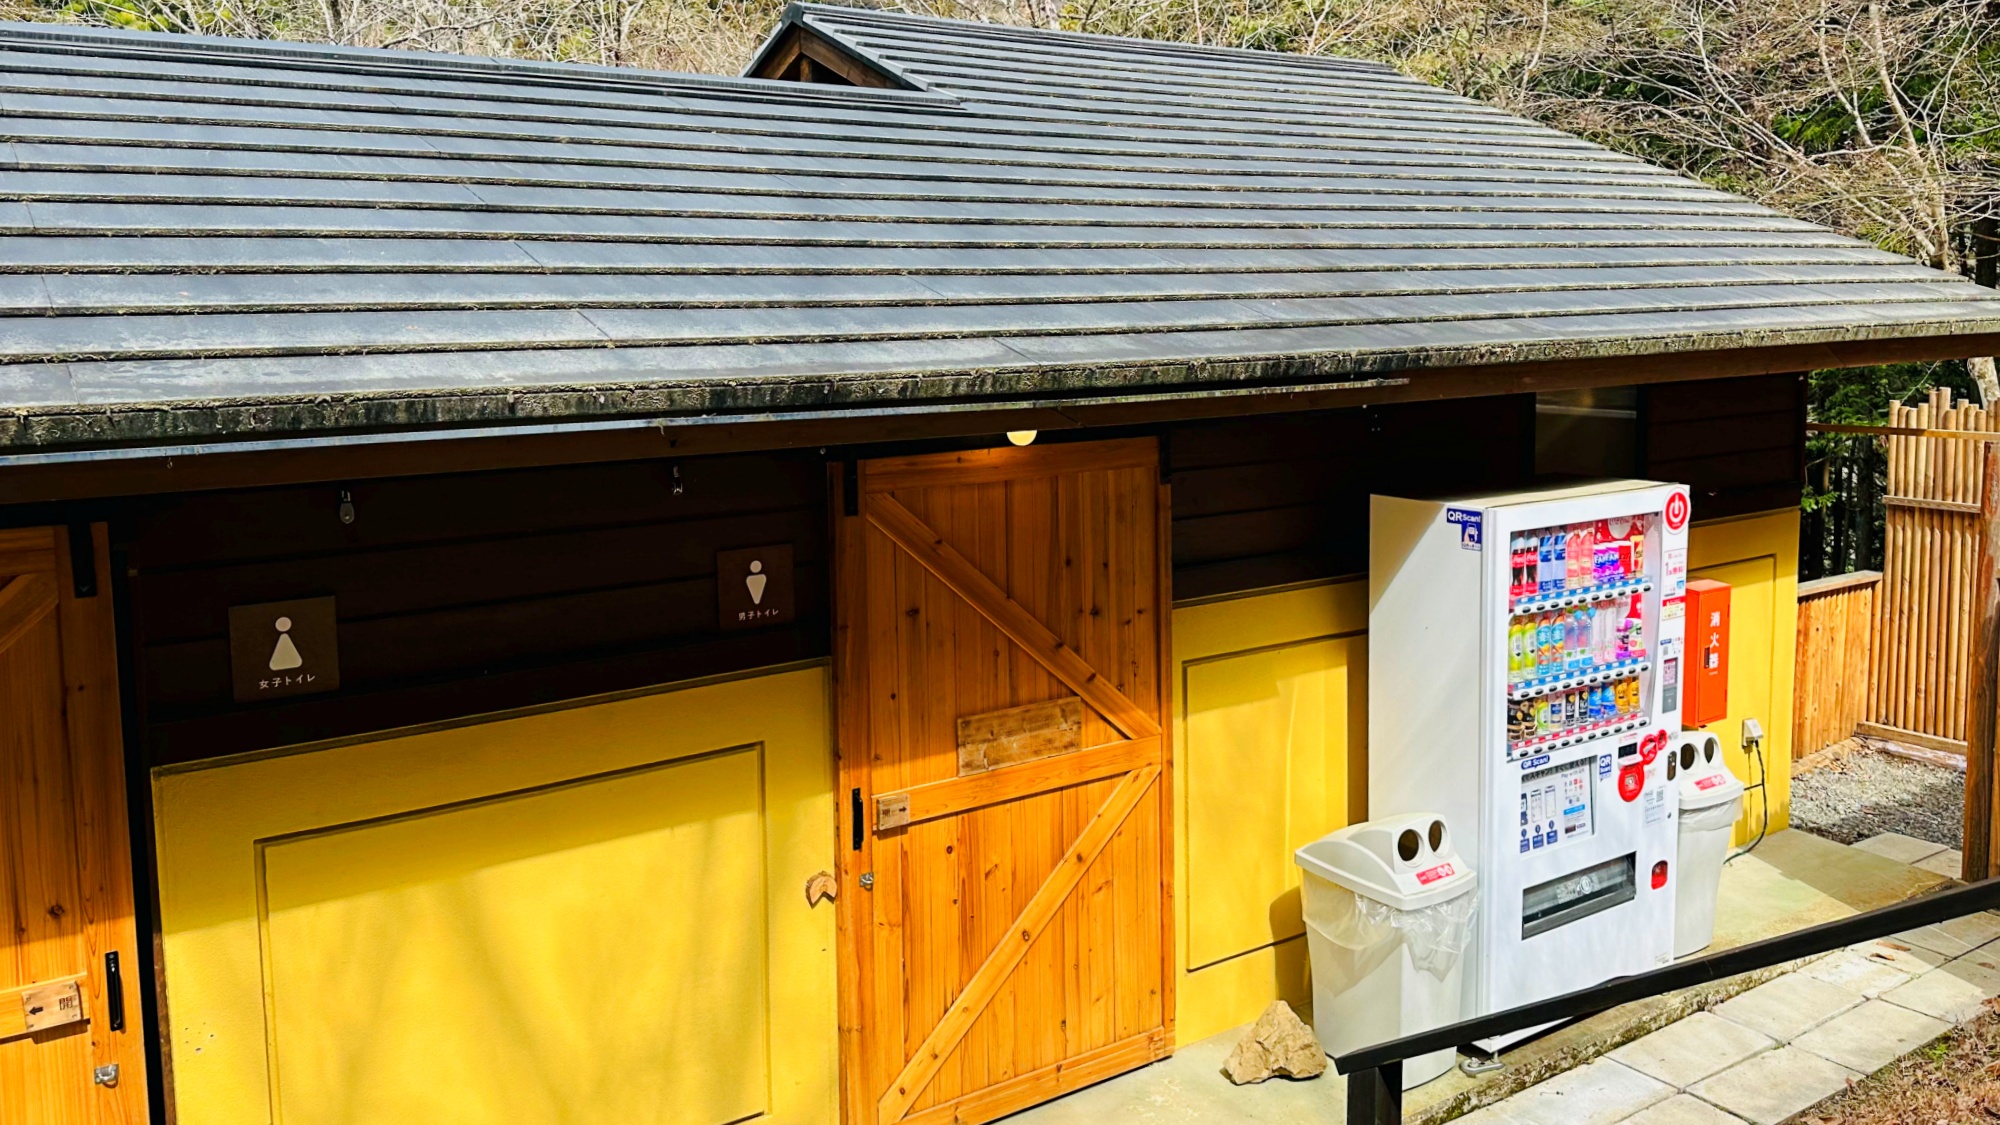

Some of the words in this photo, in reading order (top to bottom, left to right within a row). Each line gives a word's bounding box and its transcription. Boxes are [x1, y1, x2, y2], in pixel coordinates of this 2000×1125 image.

[1448, 511, 1462, 521] QR
[738, 608, 779, 621] 男子トイレ
[1709, 610, 1720, 669] 消火器
[259, 674, 315, 689] 女子トイレ
[1600, 756, 1611, 767] QR
